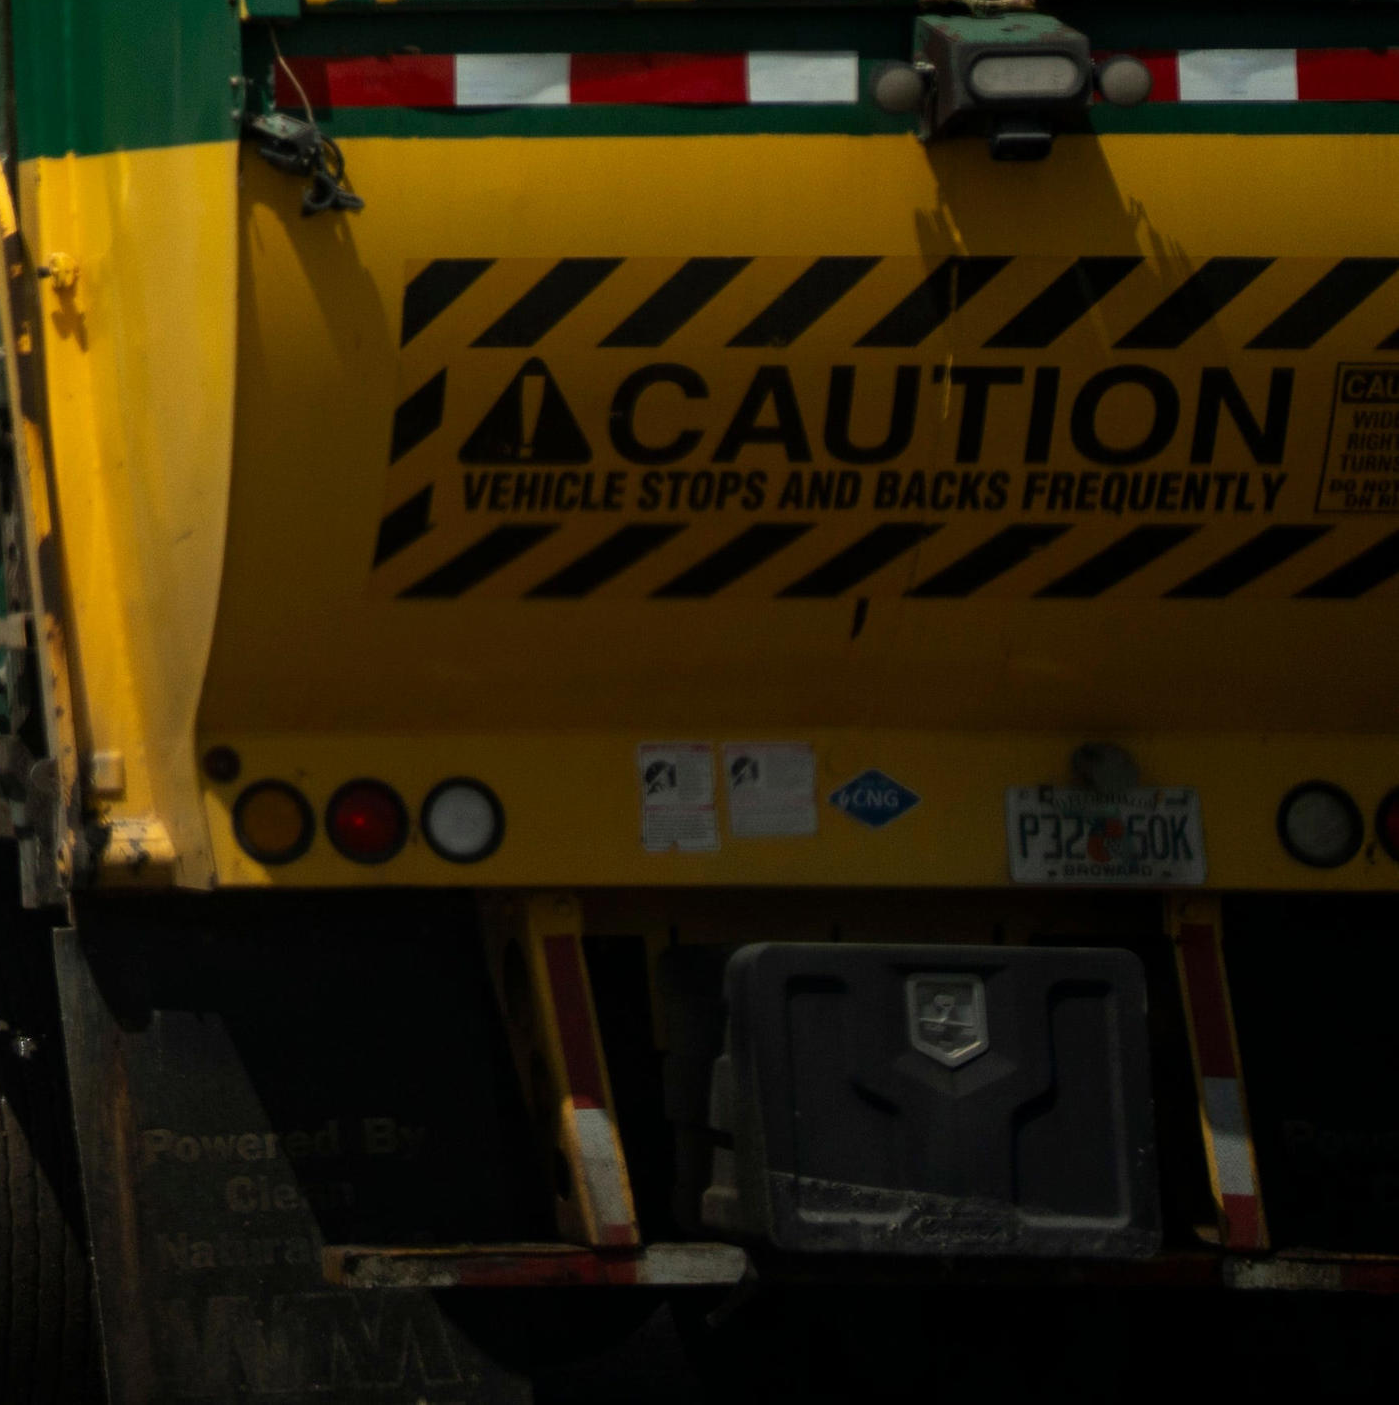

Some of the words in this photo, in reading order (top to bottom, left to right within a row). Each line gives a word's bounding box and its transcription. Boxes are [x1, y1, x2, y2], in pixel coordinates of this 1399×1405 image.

[607, 361, 1297, 465] CAUTION
[461, 472, 628, 514] VEHICLE
[636, 470, 768, 514] STOPS
[778, 471, 864, 514] AND
[871, 470, 1012, 514] BACKS
[1020, 470, 1289, 515] FREQUENTLY
[851, 786, 900, 809] CNG
[142, 1116, 344, 1164] Powered
